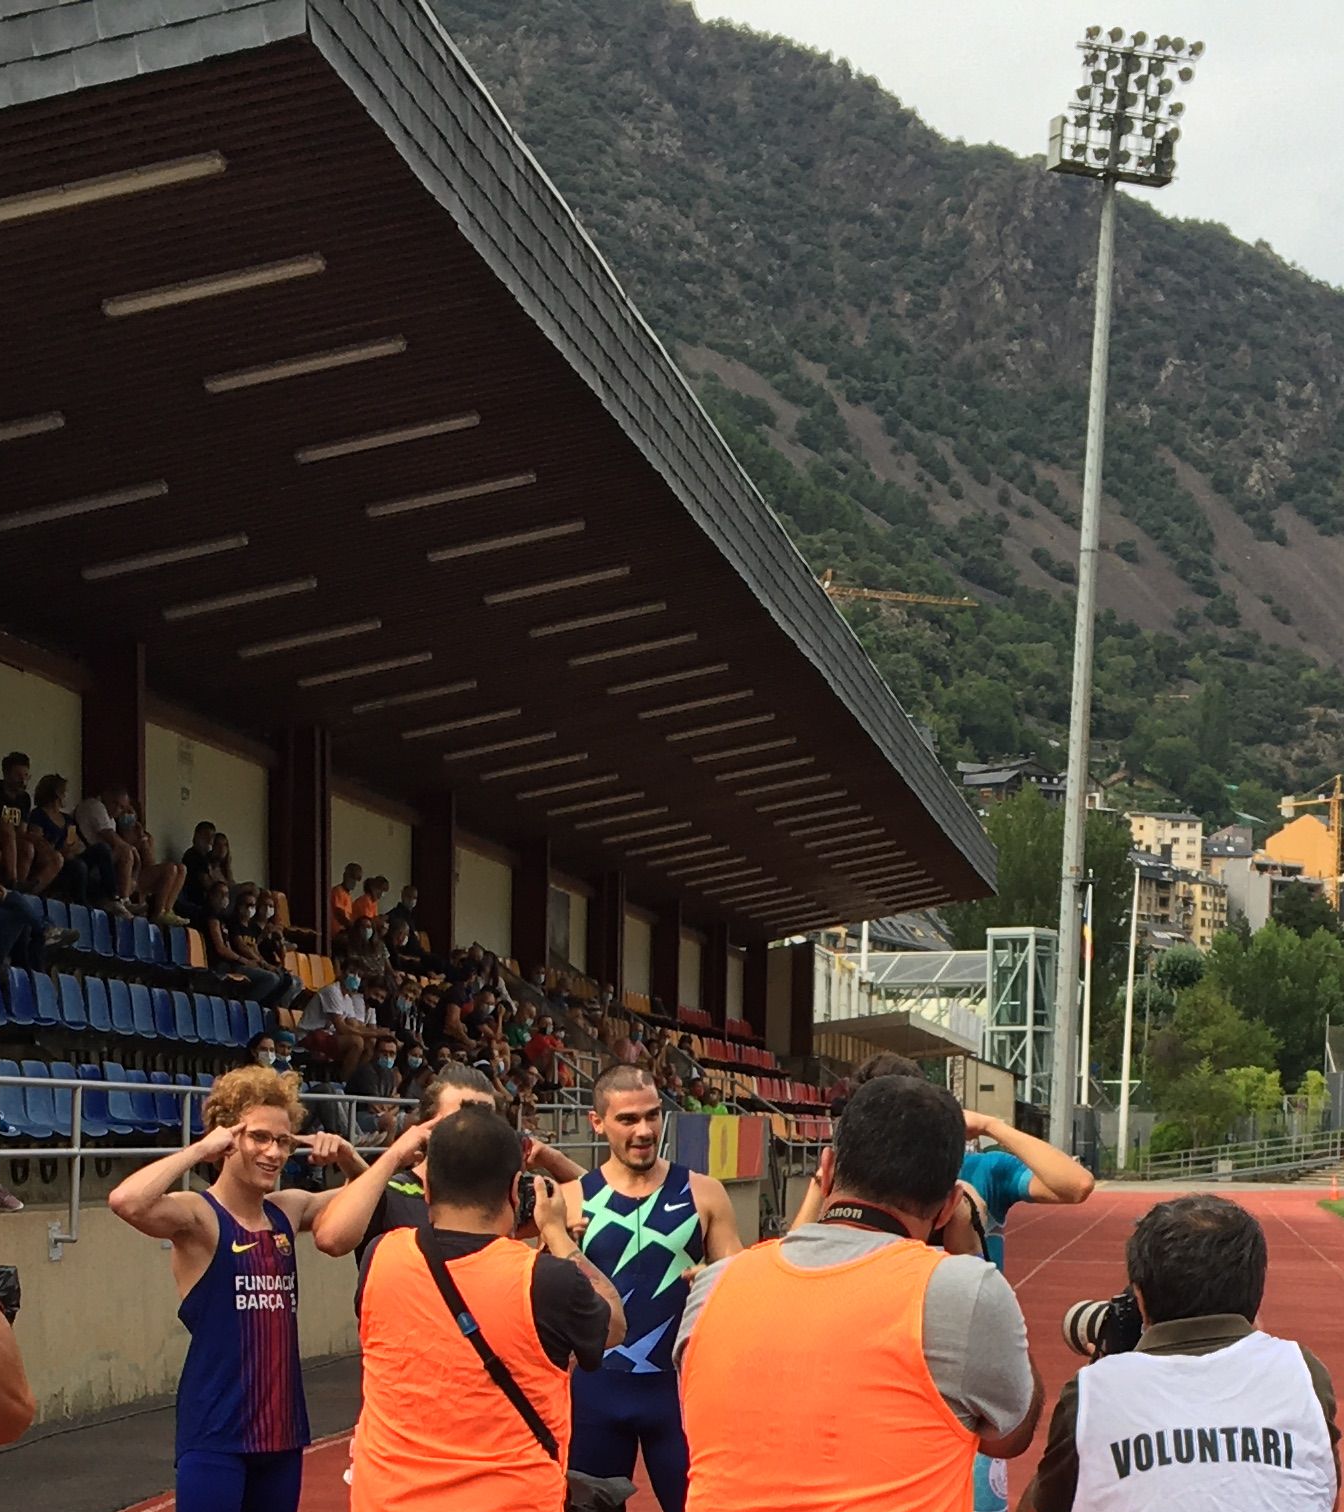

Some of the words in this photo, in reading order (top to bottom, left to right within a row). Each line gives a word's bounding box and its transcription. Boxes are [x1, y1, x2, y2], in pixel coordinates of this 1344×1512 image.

[825, 1207, 863, 1220] anon
[235, 1293, 285, 1312] BARÇA
[1109, 1426, 1294, 1480] VOLUNTARI
